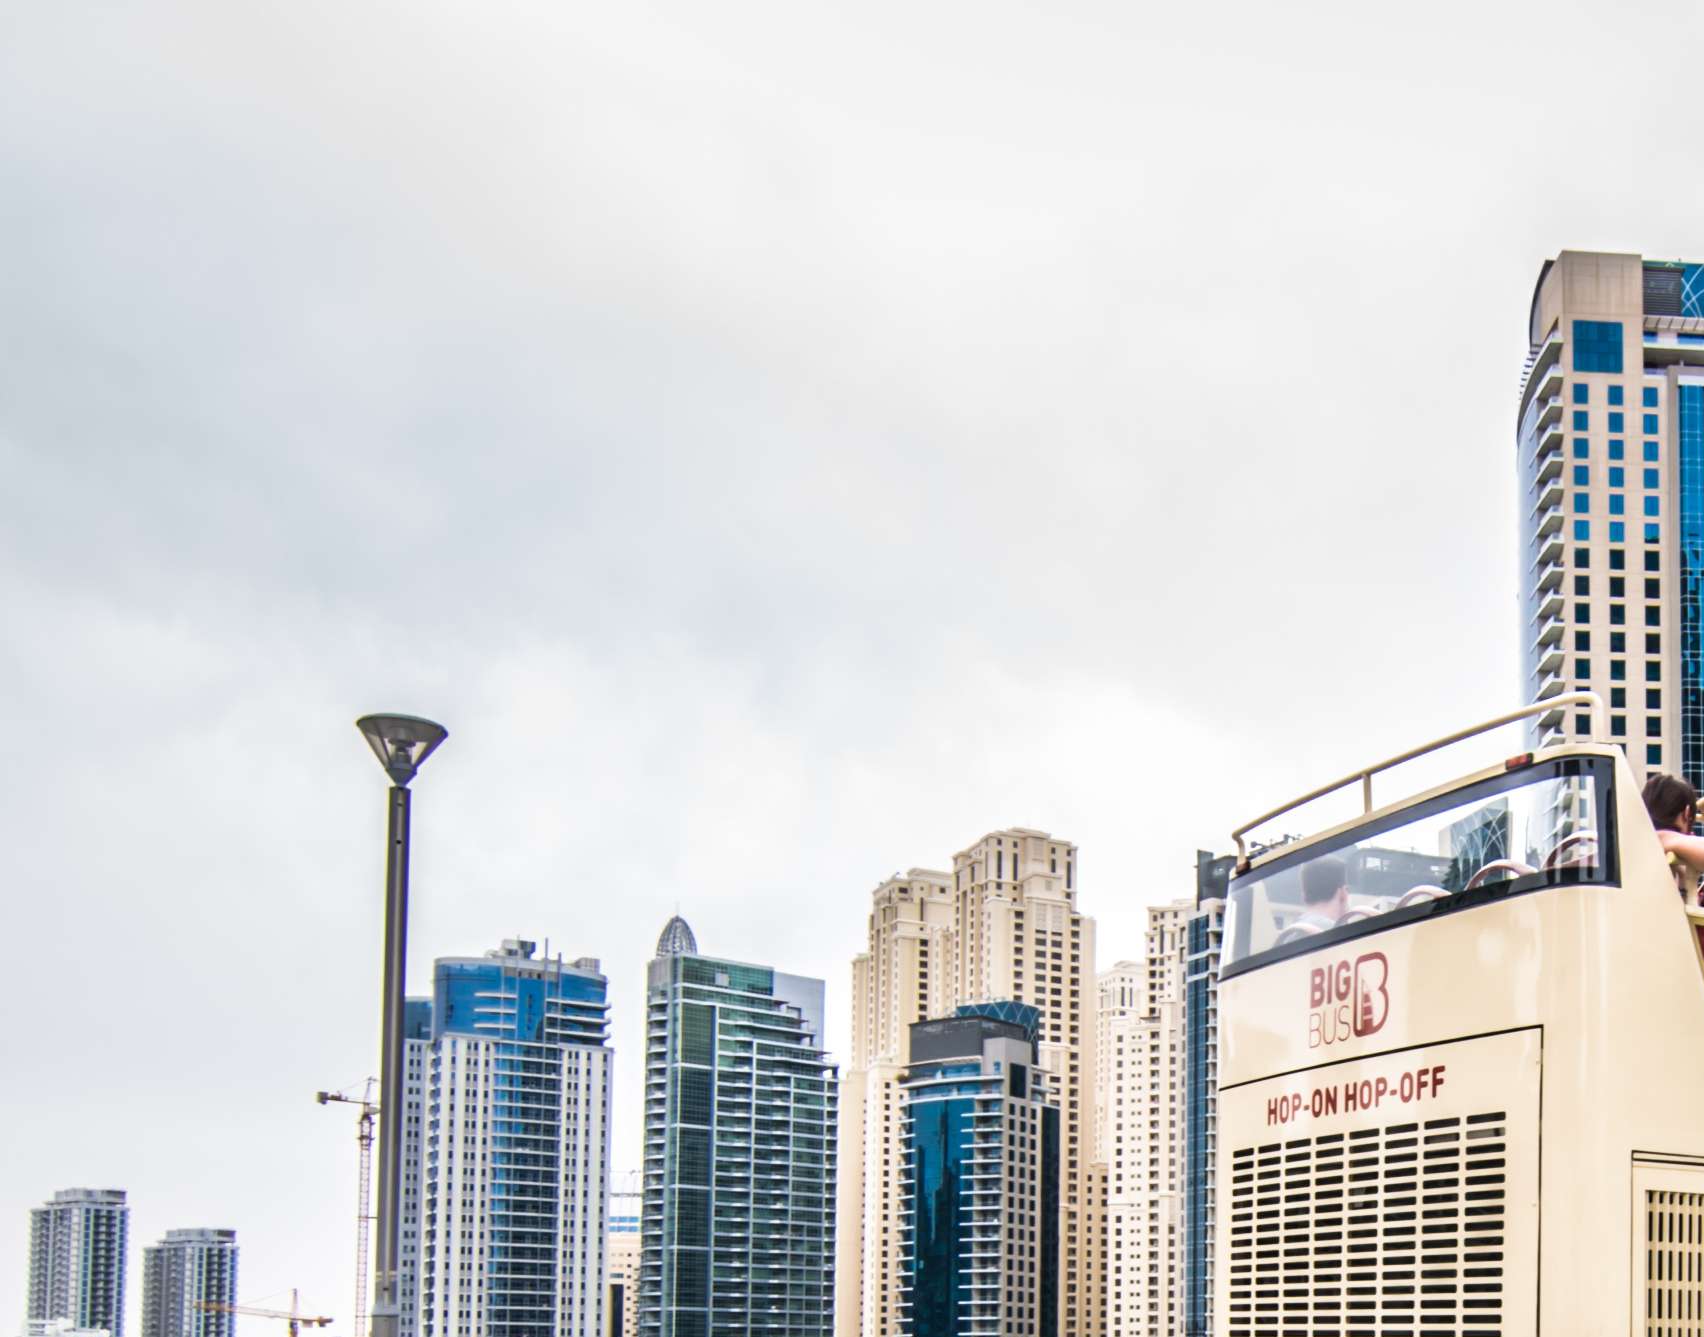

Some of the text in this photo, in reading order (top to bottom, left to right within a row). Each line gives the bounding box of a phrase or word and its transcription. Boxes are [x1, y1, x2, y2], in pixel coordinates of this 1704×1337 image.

[1311, 959, 1351, 1008] BIG
[1309, 1004, 1351, 1048] BUS
[1267, 1065, 1446, 1126] HOP-ON HOP-OFF
